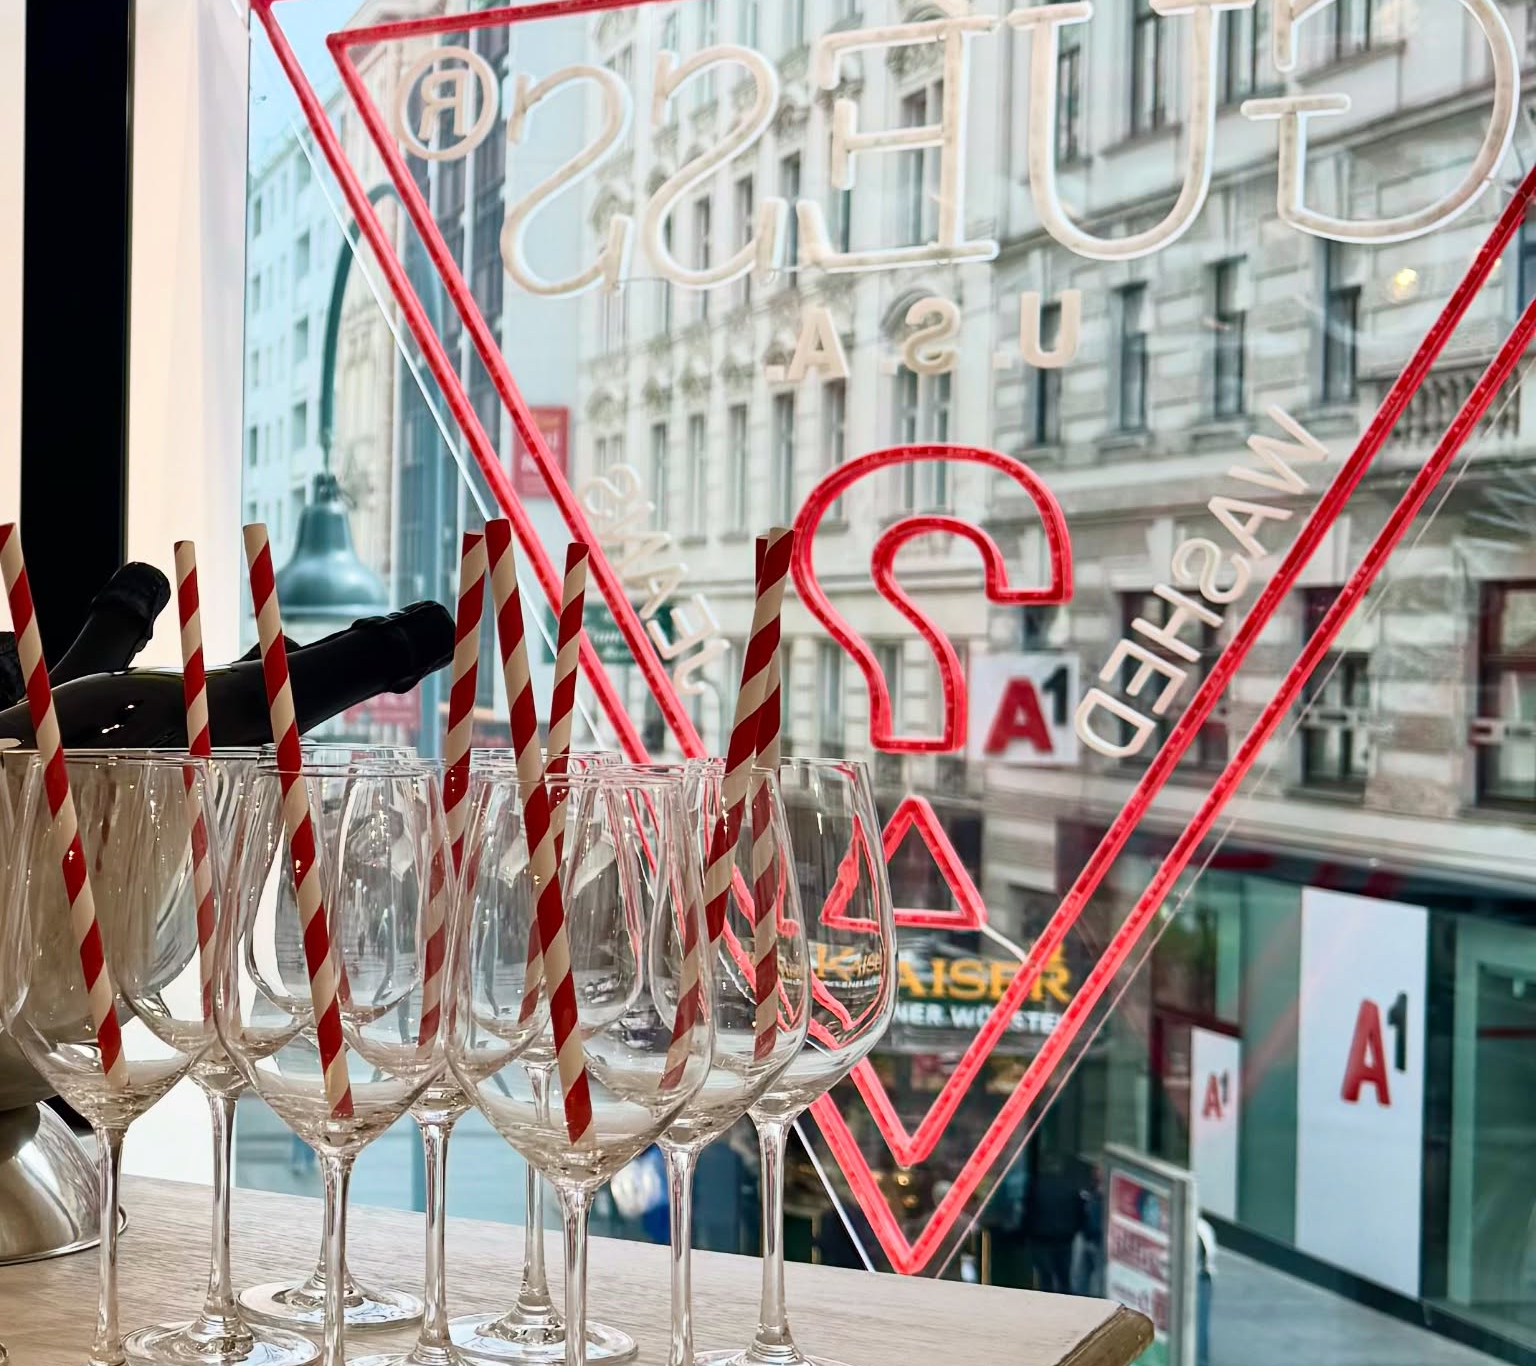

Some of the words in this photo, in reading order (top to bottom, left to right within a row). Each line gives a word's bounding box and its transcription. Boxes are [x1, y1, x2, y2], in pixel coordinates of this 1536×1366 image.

[983, 663, 1069, 754] A1
[1203, 1069, 1228, 1120] A1
[1341, 991, 1407, 1108] A1
